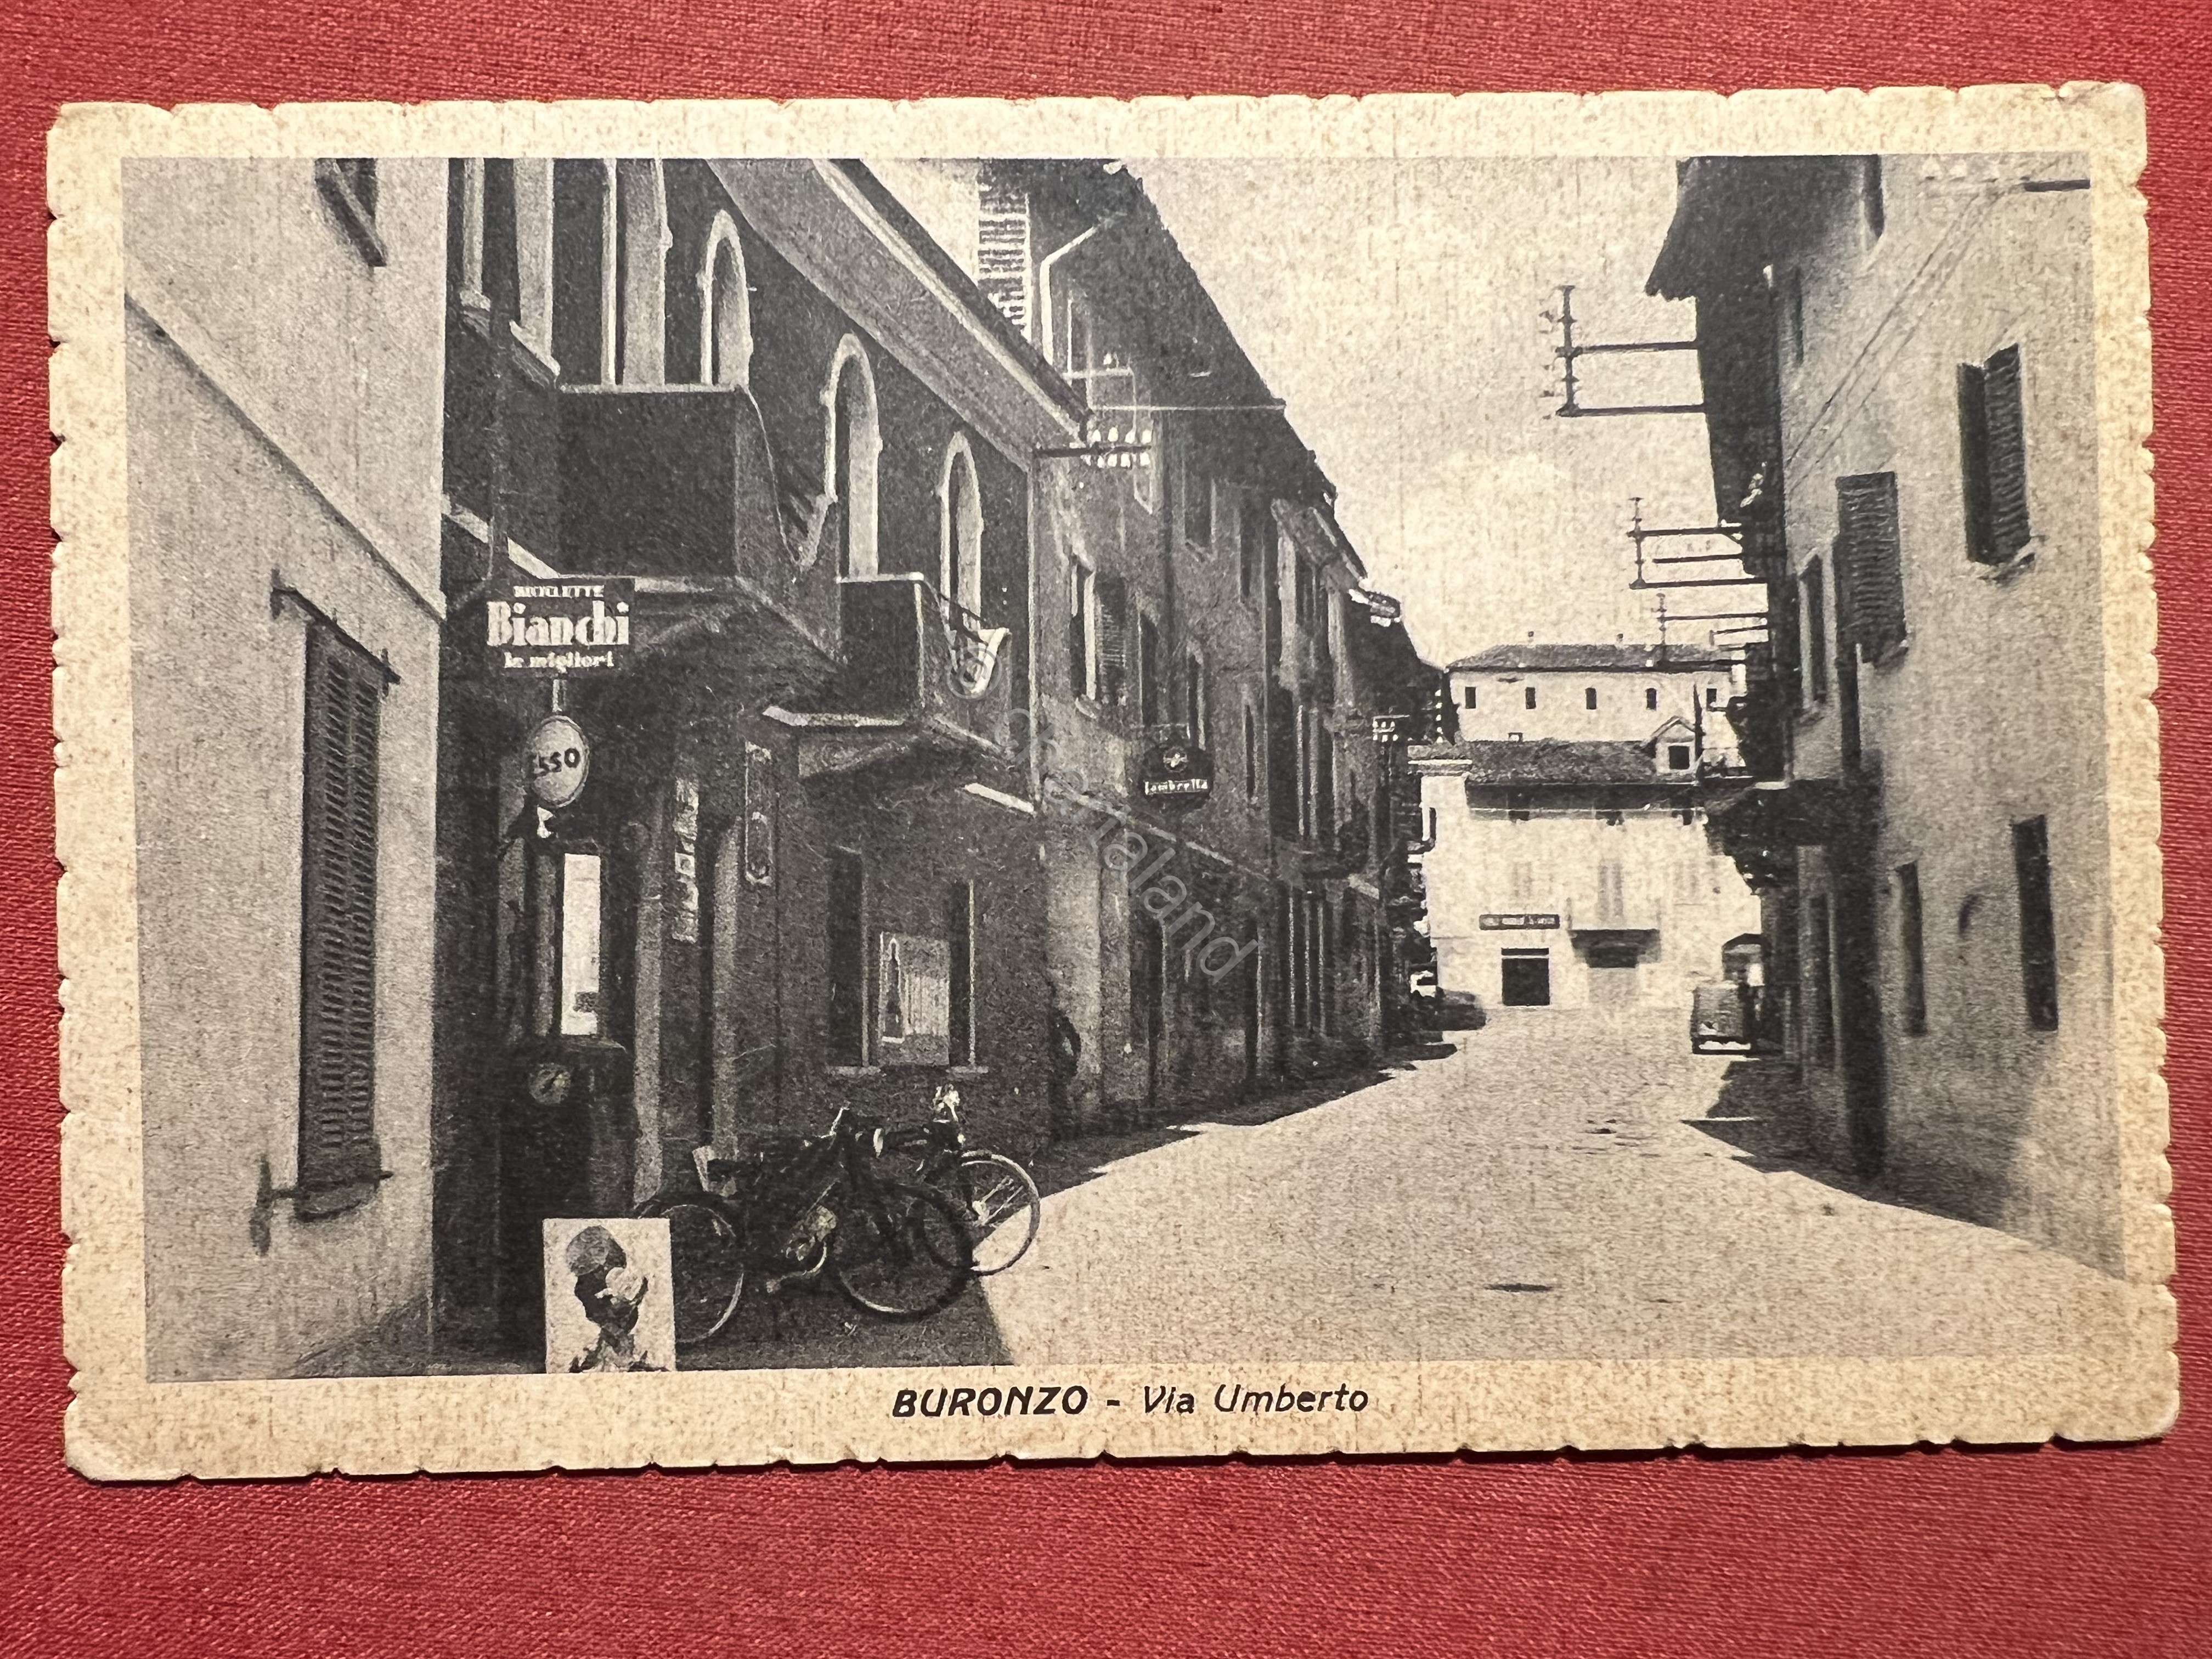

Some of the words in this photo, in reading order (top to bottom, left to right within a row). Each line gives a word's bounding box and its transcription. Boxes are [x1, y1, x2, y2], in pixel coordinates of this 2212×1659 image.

[486, 600, 629, 646] Bianchi
[892, 1385, 1088, 1417] BURONZO
[1144, 1385, 1195, 1414] Via
[1214, 1383, 1369, 1413] Umberto
